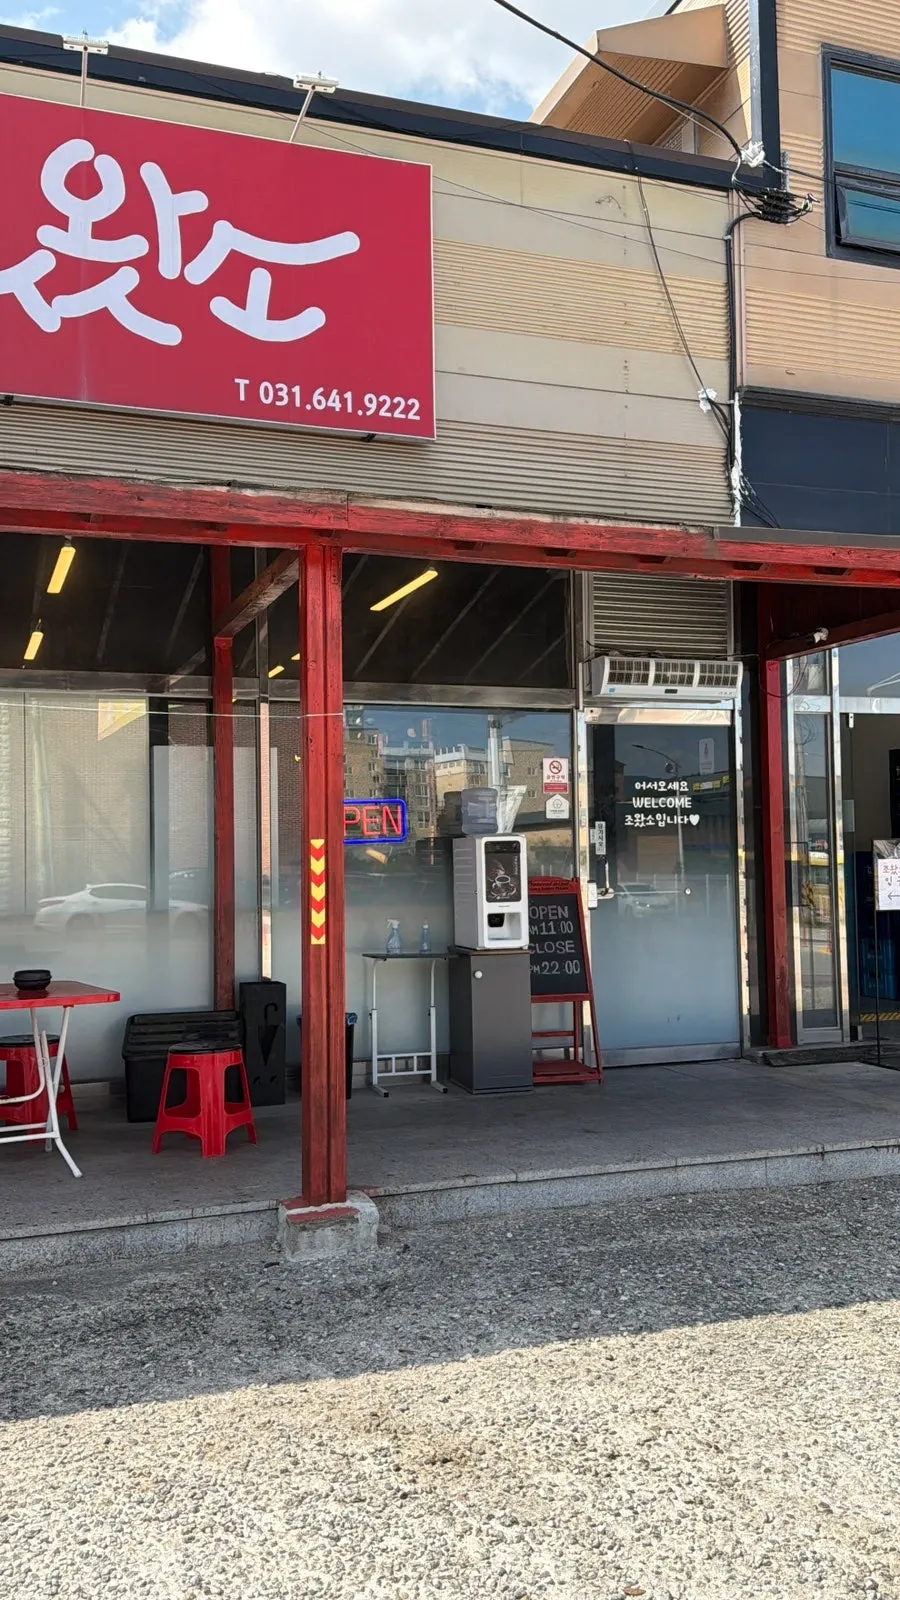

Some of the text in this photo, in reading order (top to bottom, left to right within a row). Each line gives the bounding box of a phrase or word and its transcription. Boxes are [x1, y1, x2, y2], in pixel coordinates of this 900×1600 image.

[234, 378, 420, 420] T 031.641.9222
[634, 781, 689, 791] 어서오세요
[632, 797, 692, 808] WELCOME
[529, 905, 569, 920] OPEN
[529, 940, 576, 954] CLOSE
